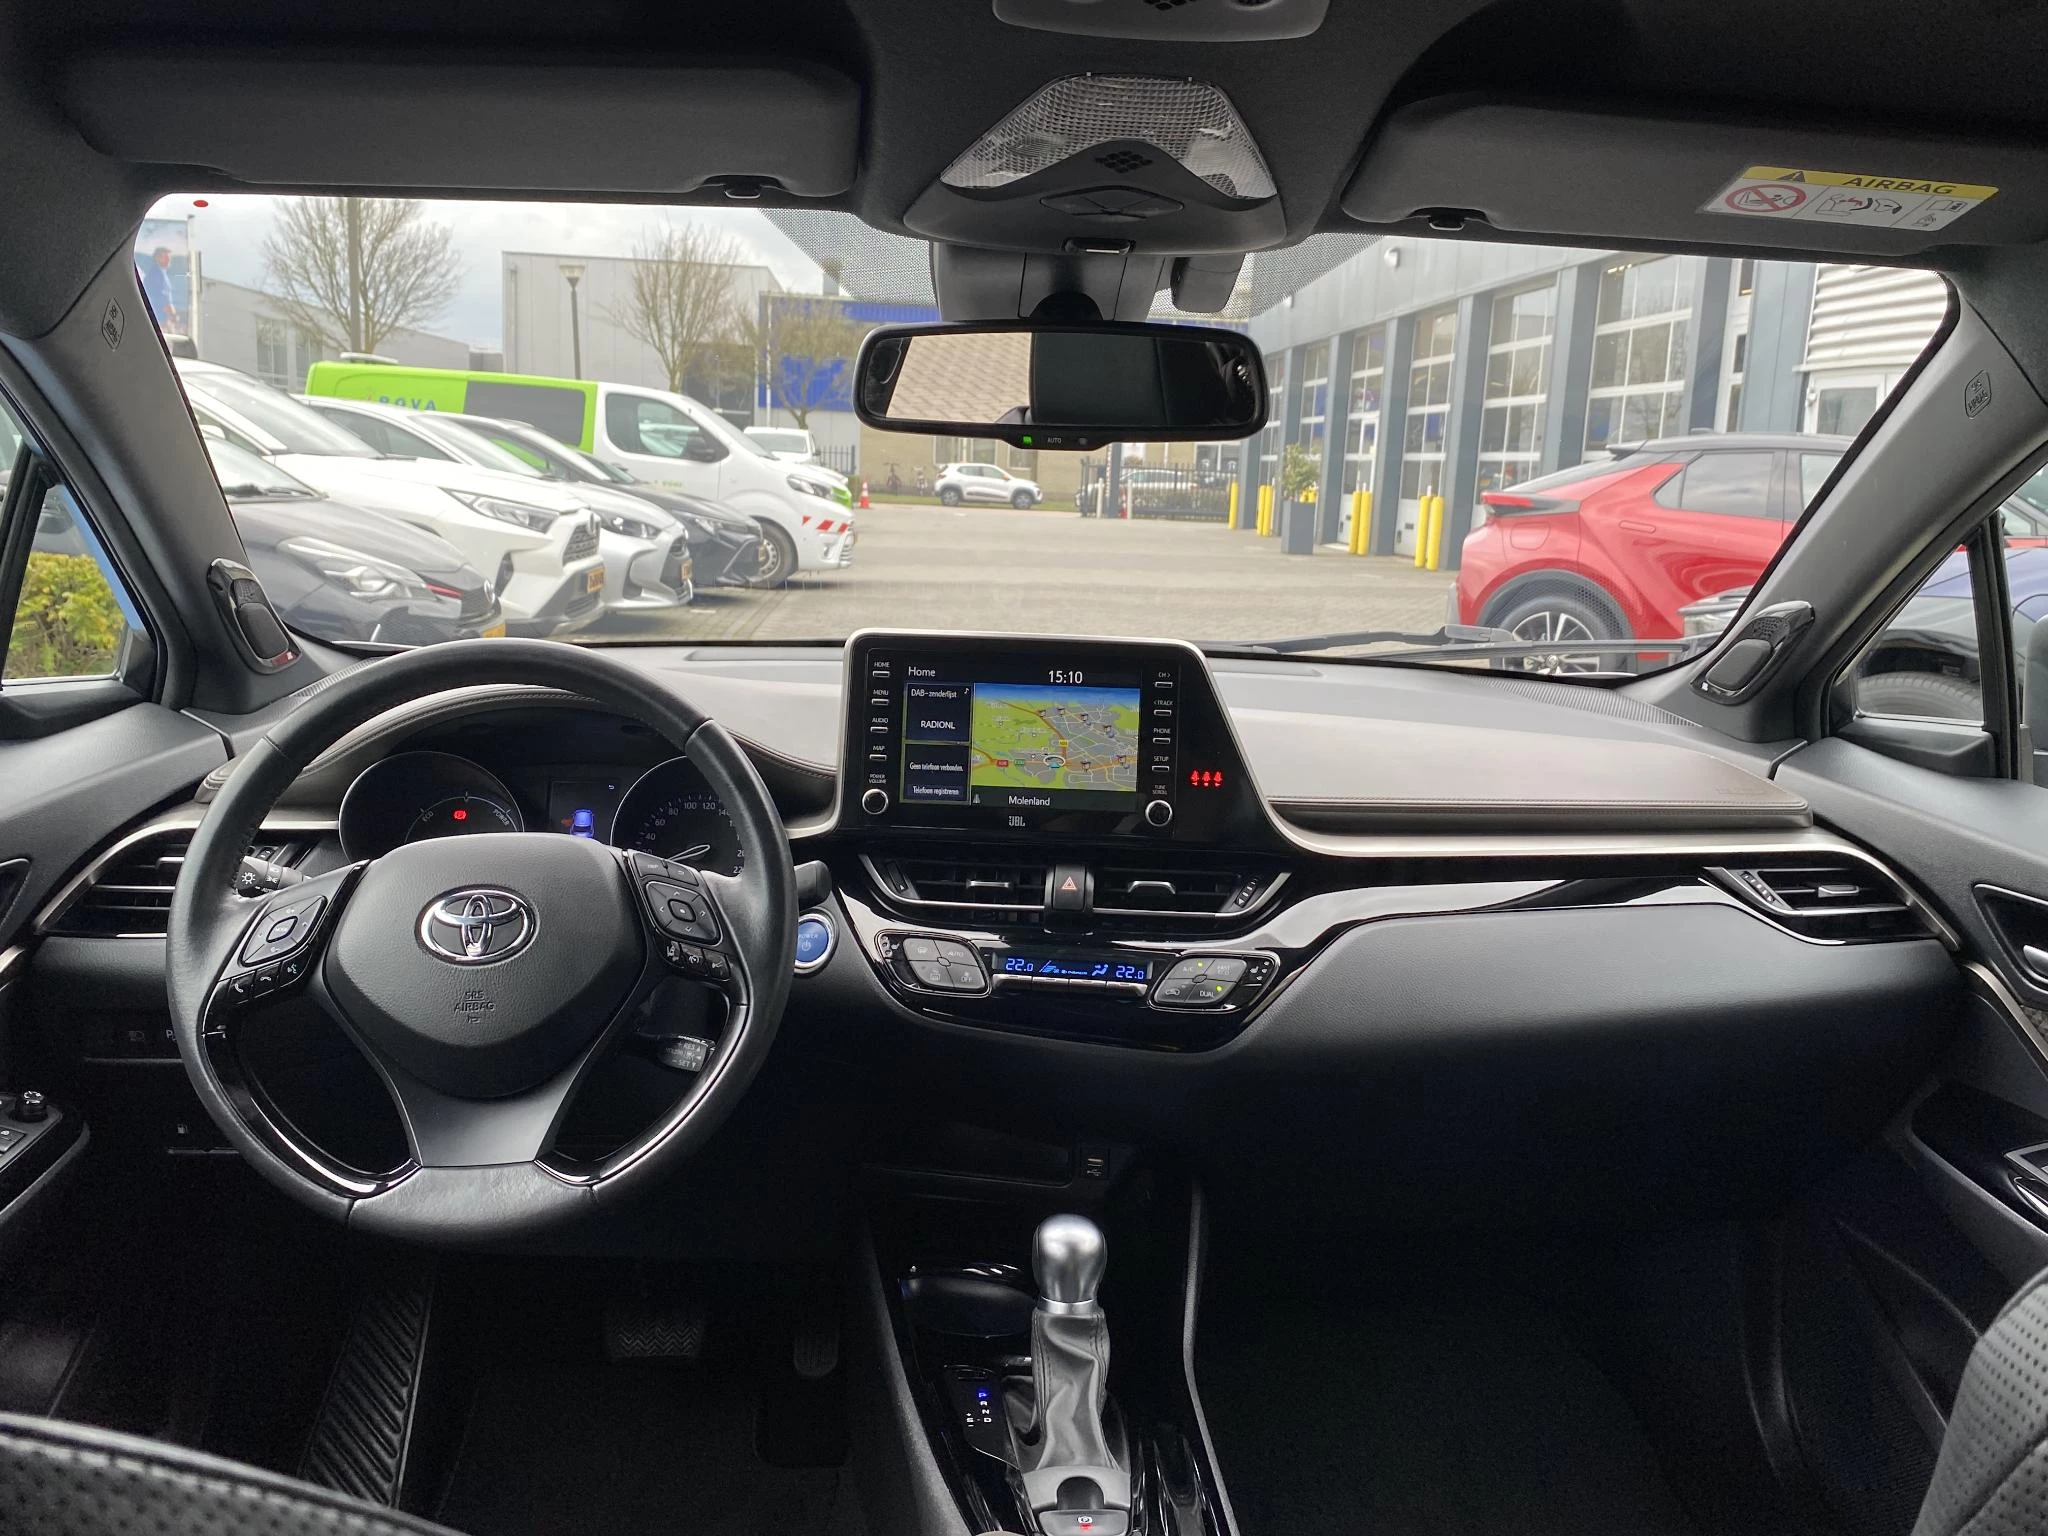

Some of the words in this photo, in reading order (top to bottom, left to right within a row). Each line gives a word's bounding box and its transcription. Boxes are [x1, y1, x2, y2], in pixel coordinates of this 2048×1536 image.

[1842, 177, 1957, 194] AIRBAG
[1047, 436, 1062, 444] AUTO
[908, 666, 936, 677] Home
[1048, 670, 1083, 684] 15:10
[920, 720, 956, 730] RADIONL
[1153, 727, 1171, 735] PHONE
[912, 785, 934, 795] Telefoon
[684, 801, 698, 810] 100
[702, 801, 716, 810] 120
[1008, 795, 1051, 807] Molenland
[668, 807, 679, 816] 80
[654, 818, 666, 827] 60
[1008, 815, 1025, 827] JBL
[645, 832, 656, 841] 40
[1005, 957, 1034, 973] 22.0
[1115, 964, 1145, 981] 22.0
[1199, 989, 1215, 999] DUAL
[453, 1001, 496, 1013] AIRBAG
